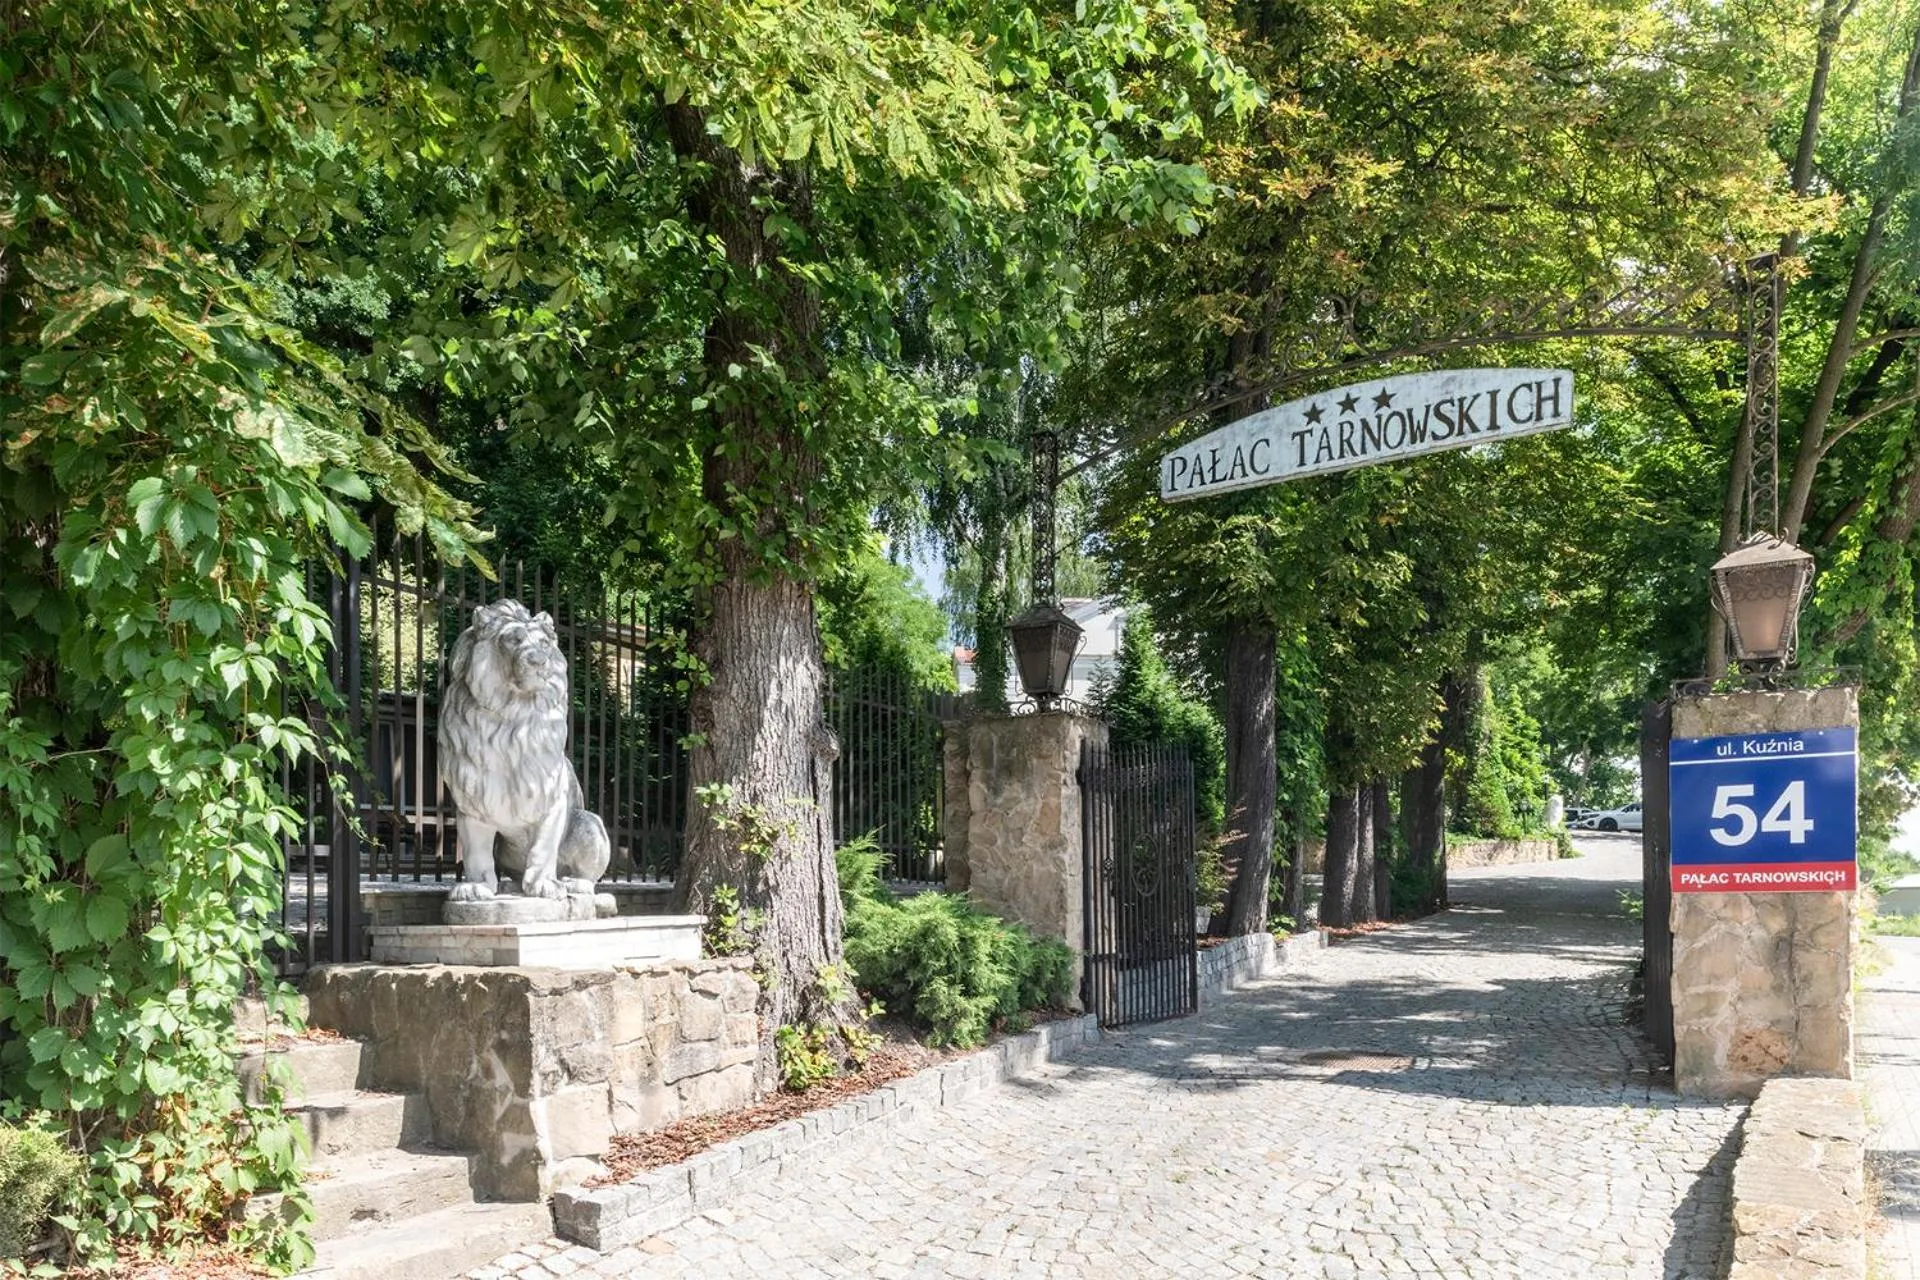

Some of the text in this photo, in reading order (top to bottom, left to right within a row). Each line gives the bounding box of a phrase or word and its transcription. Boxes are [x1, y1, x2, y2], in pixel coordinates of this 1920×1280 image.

[1168, 377, 1562, 492] PAŁAC TARNOWSKICH
[1717, 738, 1804, 756] ul. Kuźnia
[1710, 780, 1814, 846] 54
[1681, 871, 1845, 884] PAŁAC TARNOWSKICH
